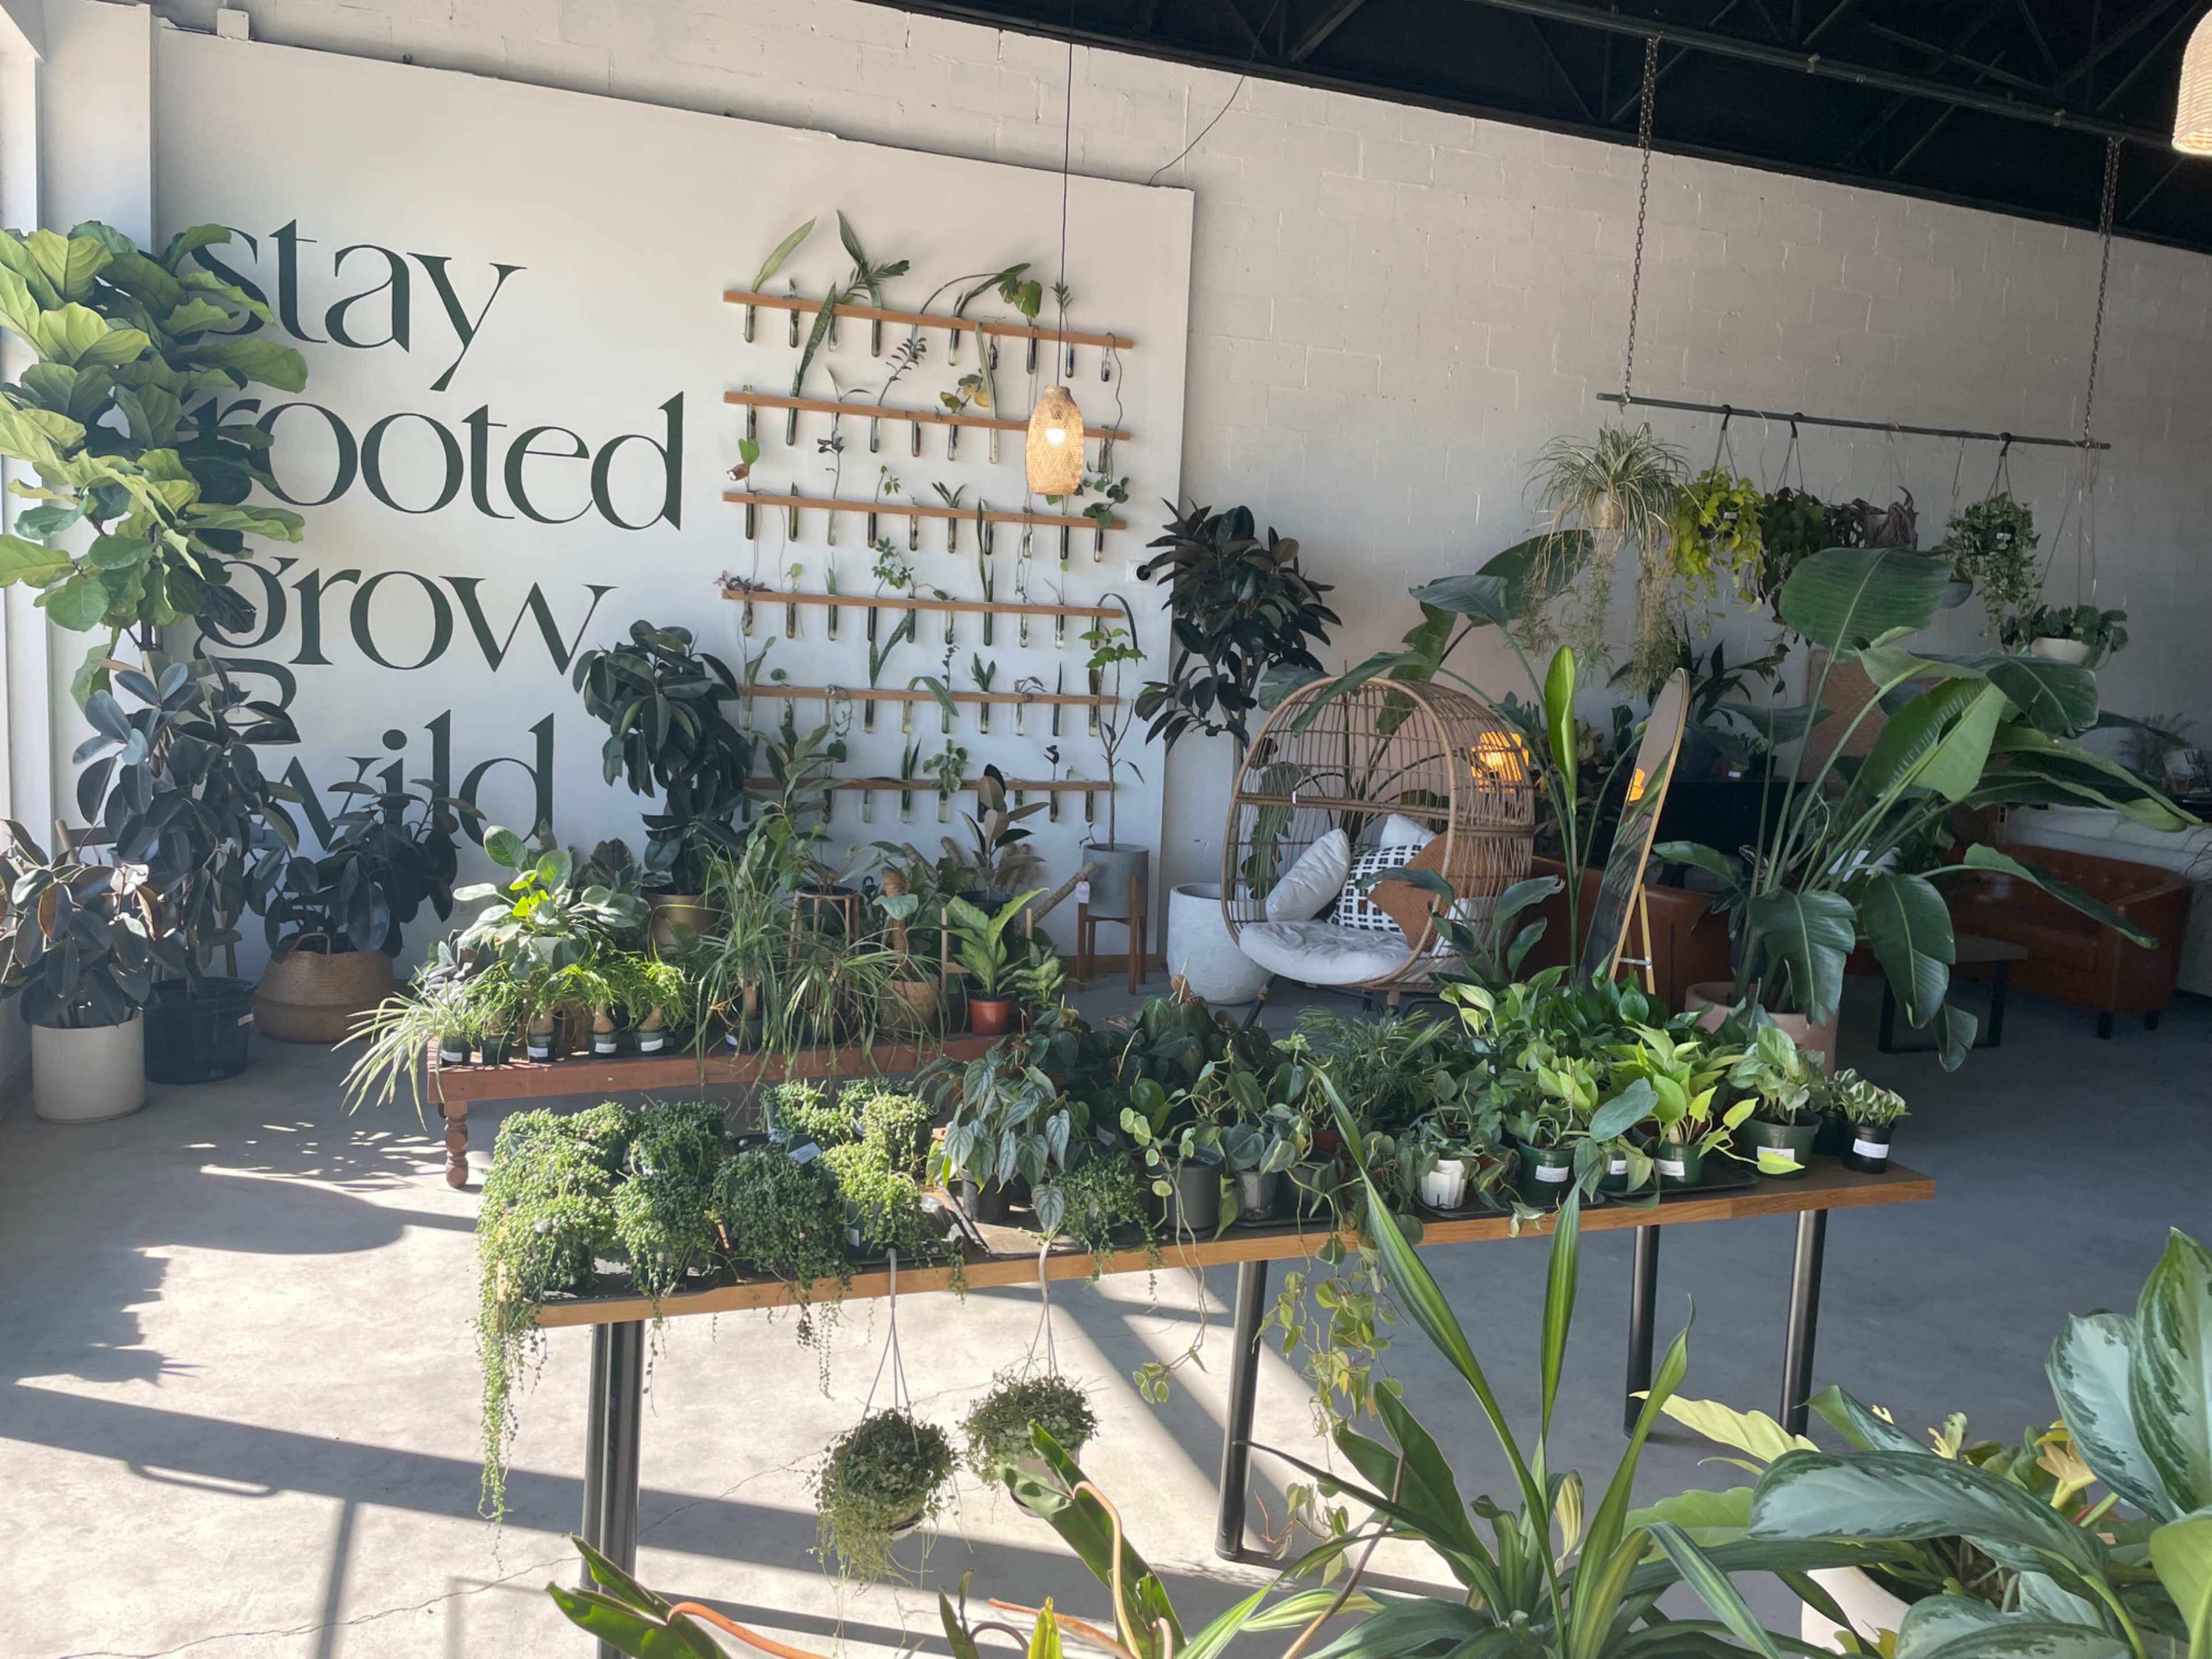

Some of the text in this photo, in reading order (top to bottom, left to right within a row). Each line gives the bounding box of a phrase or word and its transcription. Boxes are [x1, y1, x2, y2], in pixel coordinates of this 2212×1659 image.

[191, 218, 528, 392] stay
[190, 391, 684, 531] rooted
[193, 556, 619, 727] grow
